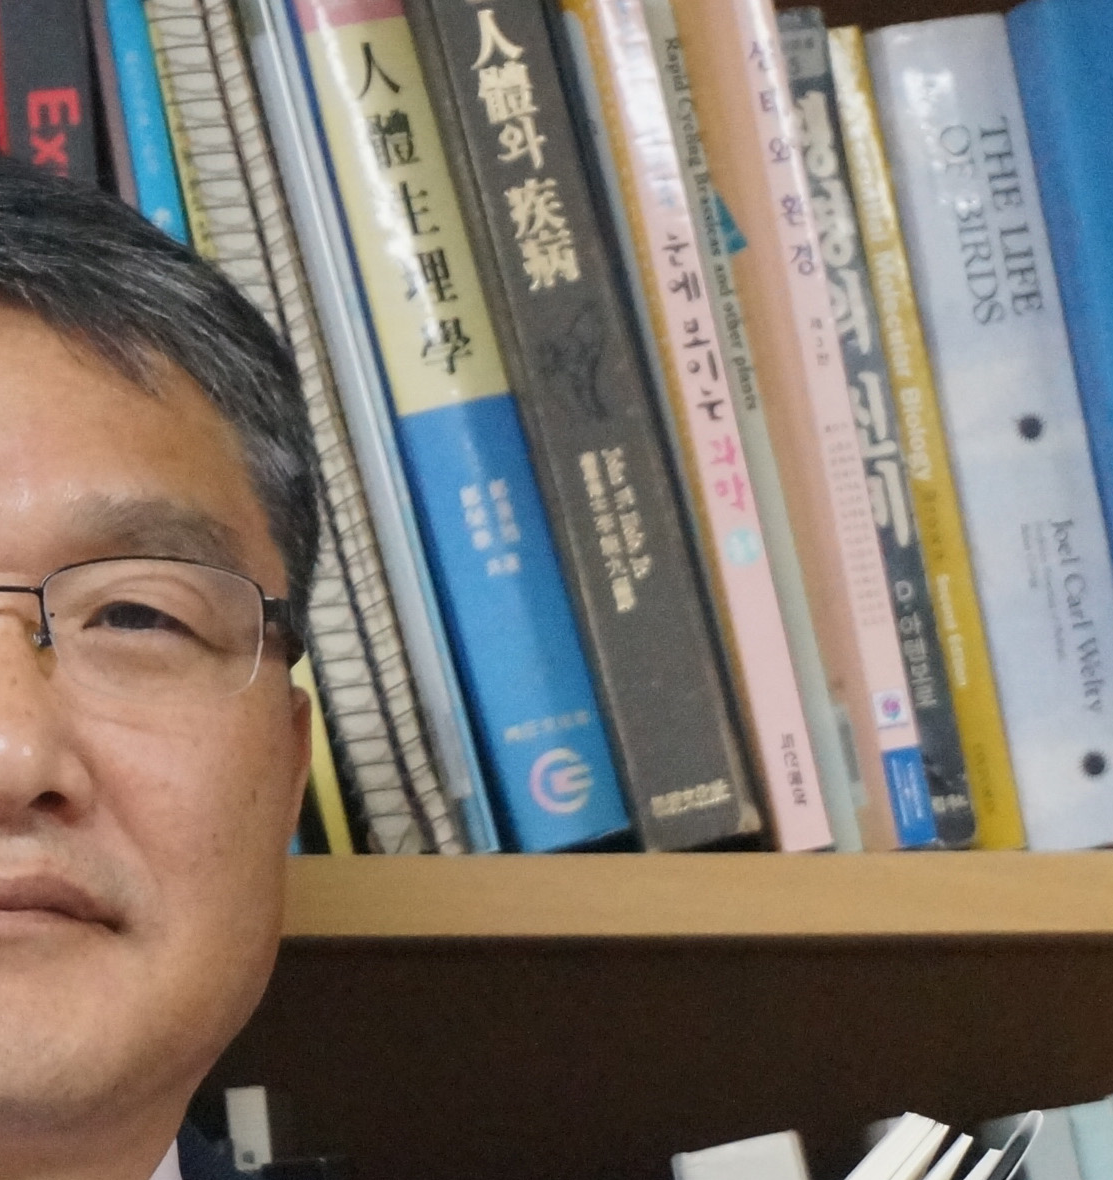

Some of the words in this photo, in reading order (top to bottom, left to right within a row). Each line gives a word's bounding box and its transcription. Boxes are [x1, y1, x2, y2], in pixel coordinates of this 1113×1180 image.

[664, 36, 690, 91] Rapid
[26, 86, 81, 176] Ex
[940, 125, 975, 178] OF
[979, 116, 1024, 212] THE
[714, 265, 734, 297] and
[955, 194, 1007, 327] BIRDS
[999, 222, 1044, 317] LIFE
[721, 302, 743, 350] other
[731, 355, 758, 412] plants
[872, 250, 915, 377] Molecular
[900, 387, 934, 480] Biology
[1050, 518, 1081, 565] Joel
[1064, 573, 1095, 630] Carl
